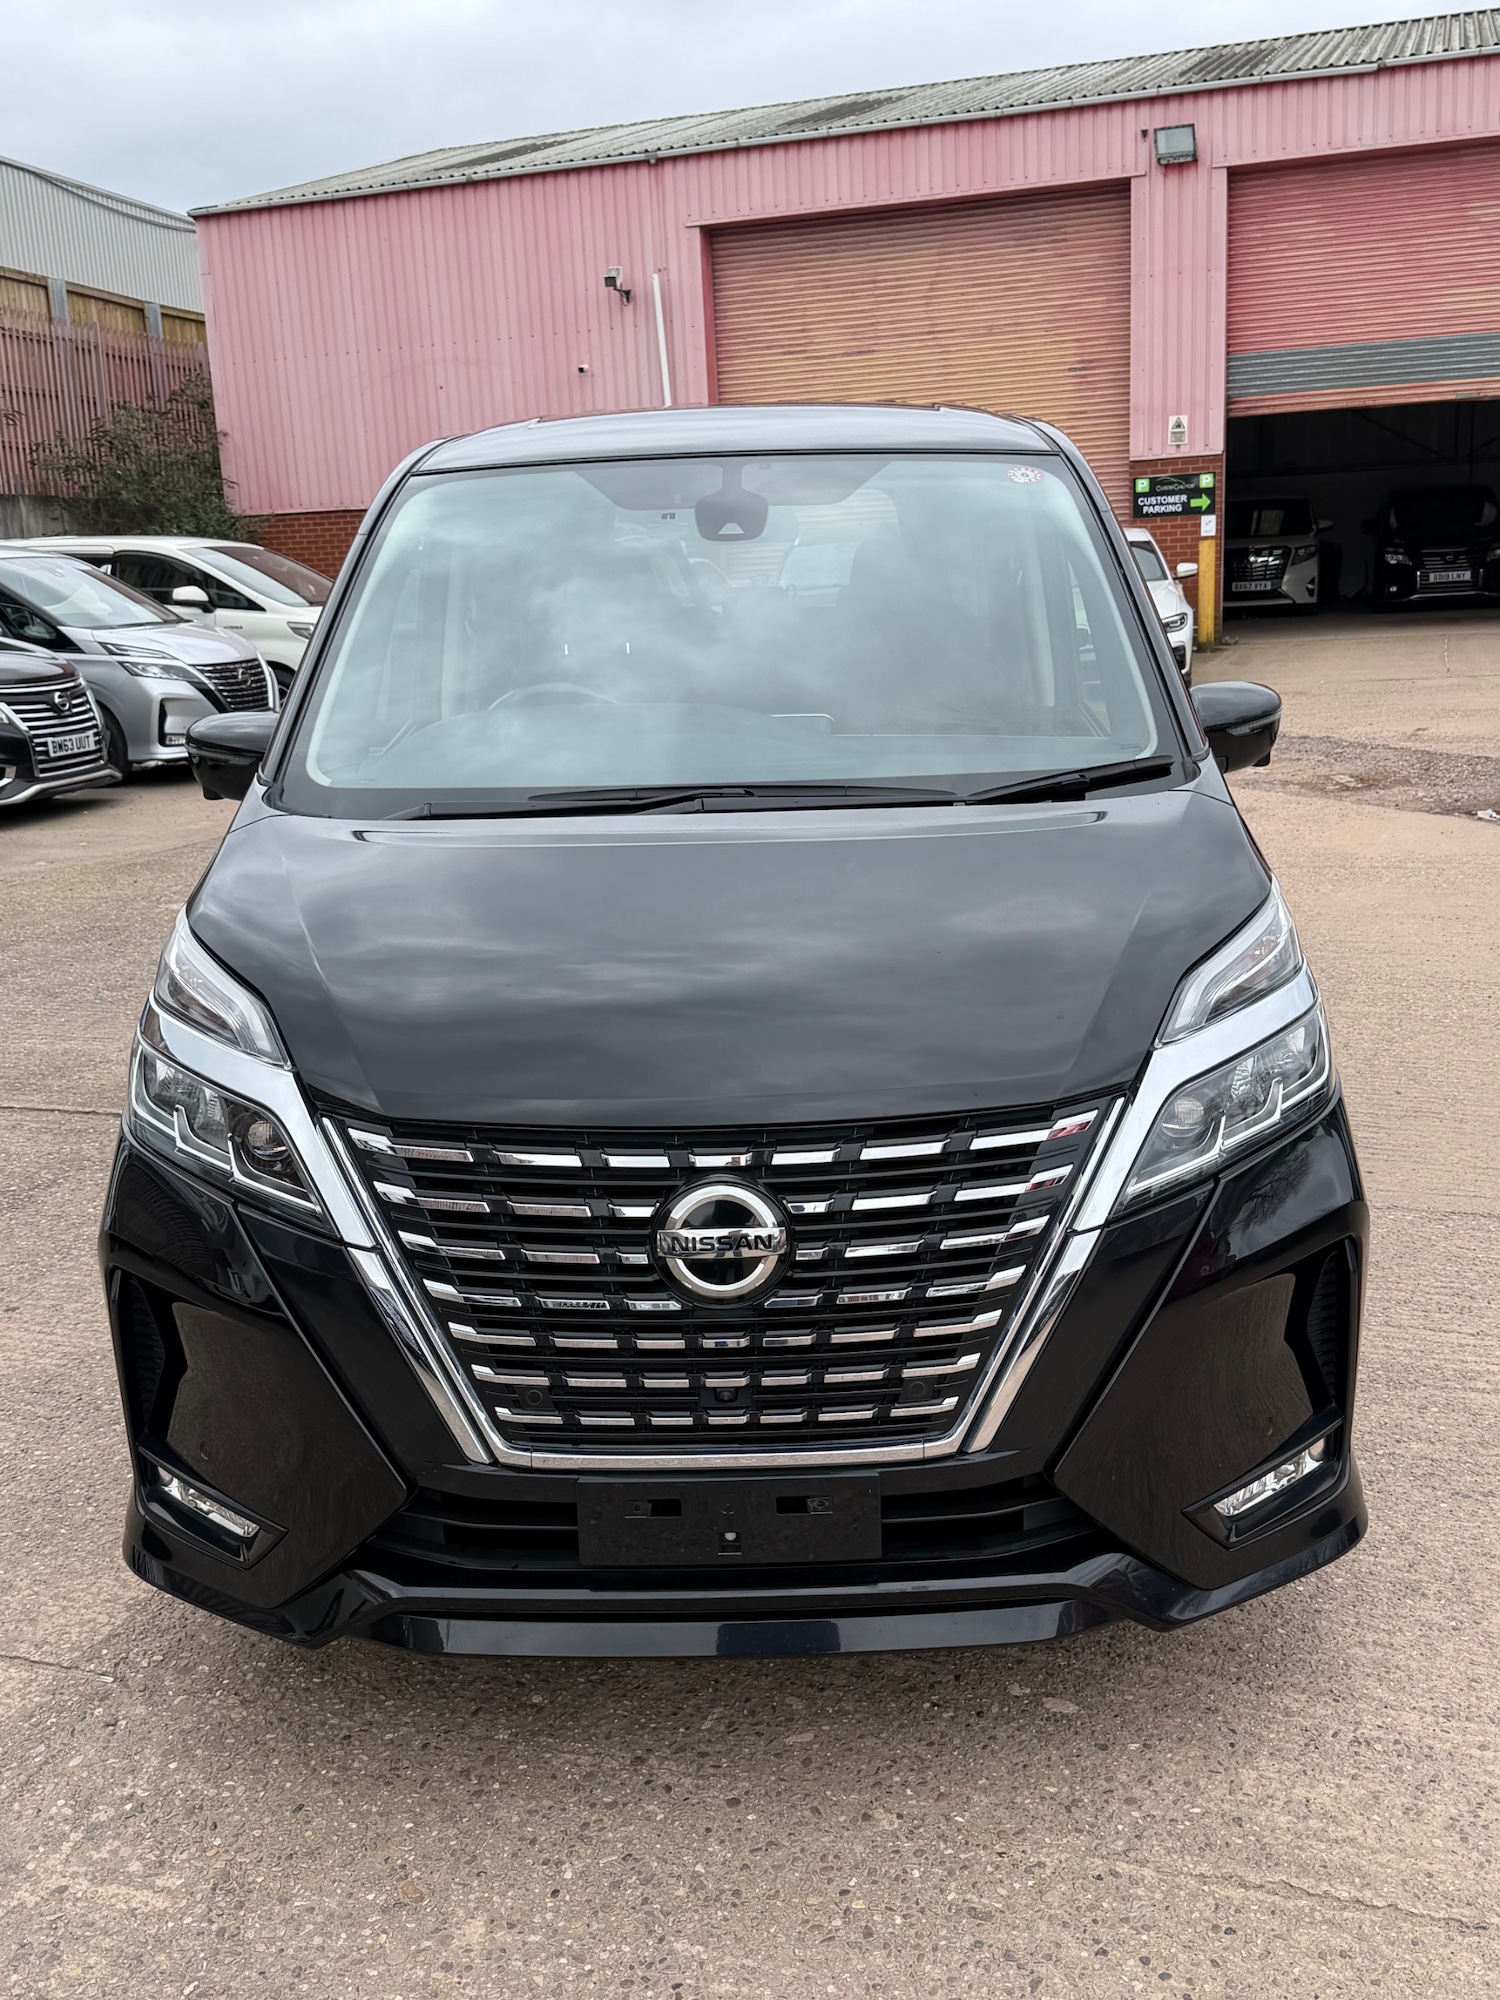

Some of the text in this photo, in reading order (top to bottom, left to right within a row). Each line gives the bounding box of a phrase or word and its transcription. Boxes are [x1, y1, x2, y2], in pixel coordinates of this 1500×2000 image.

[1137, 494, 1188, 506] CUSTOMER
[1142, 503, 1183, 514] PARKING
[75, 735, 91, 750] UUT
[671, 1233, 773, 1252] NISSAN
